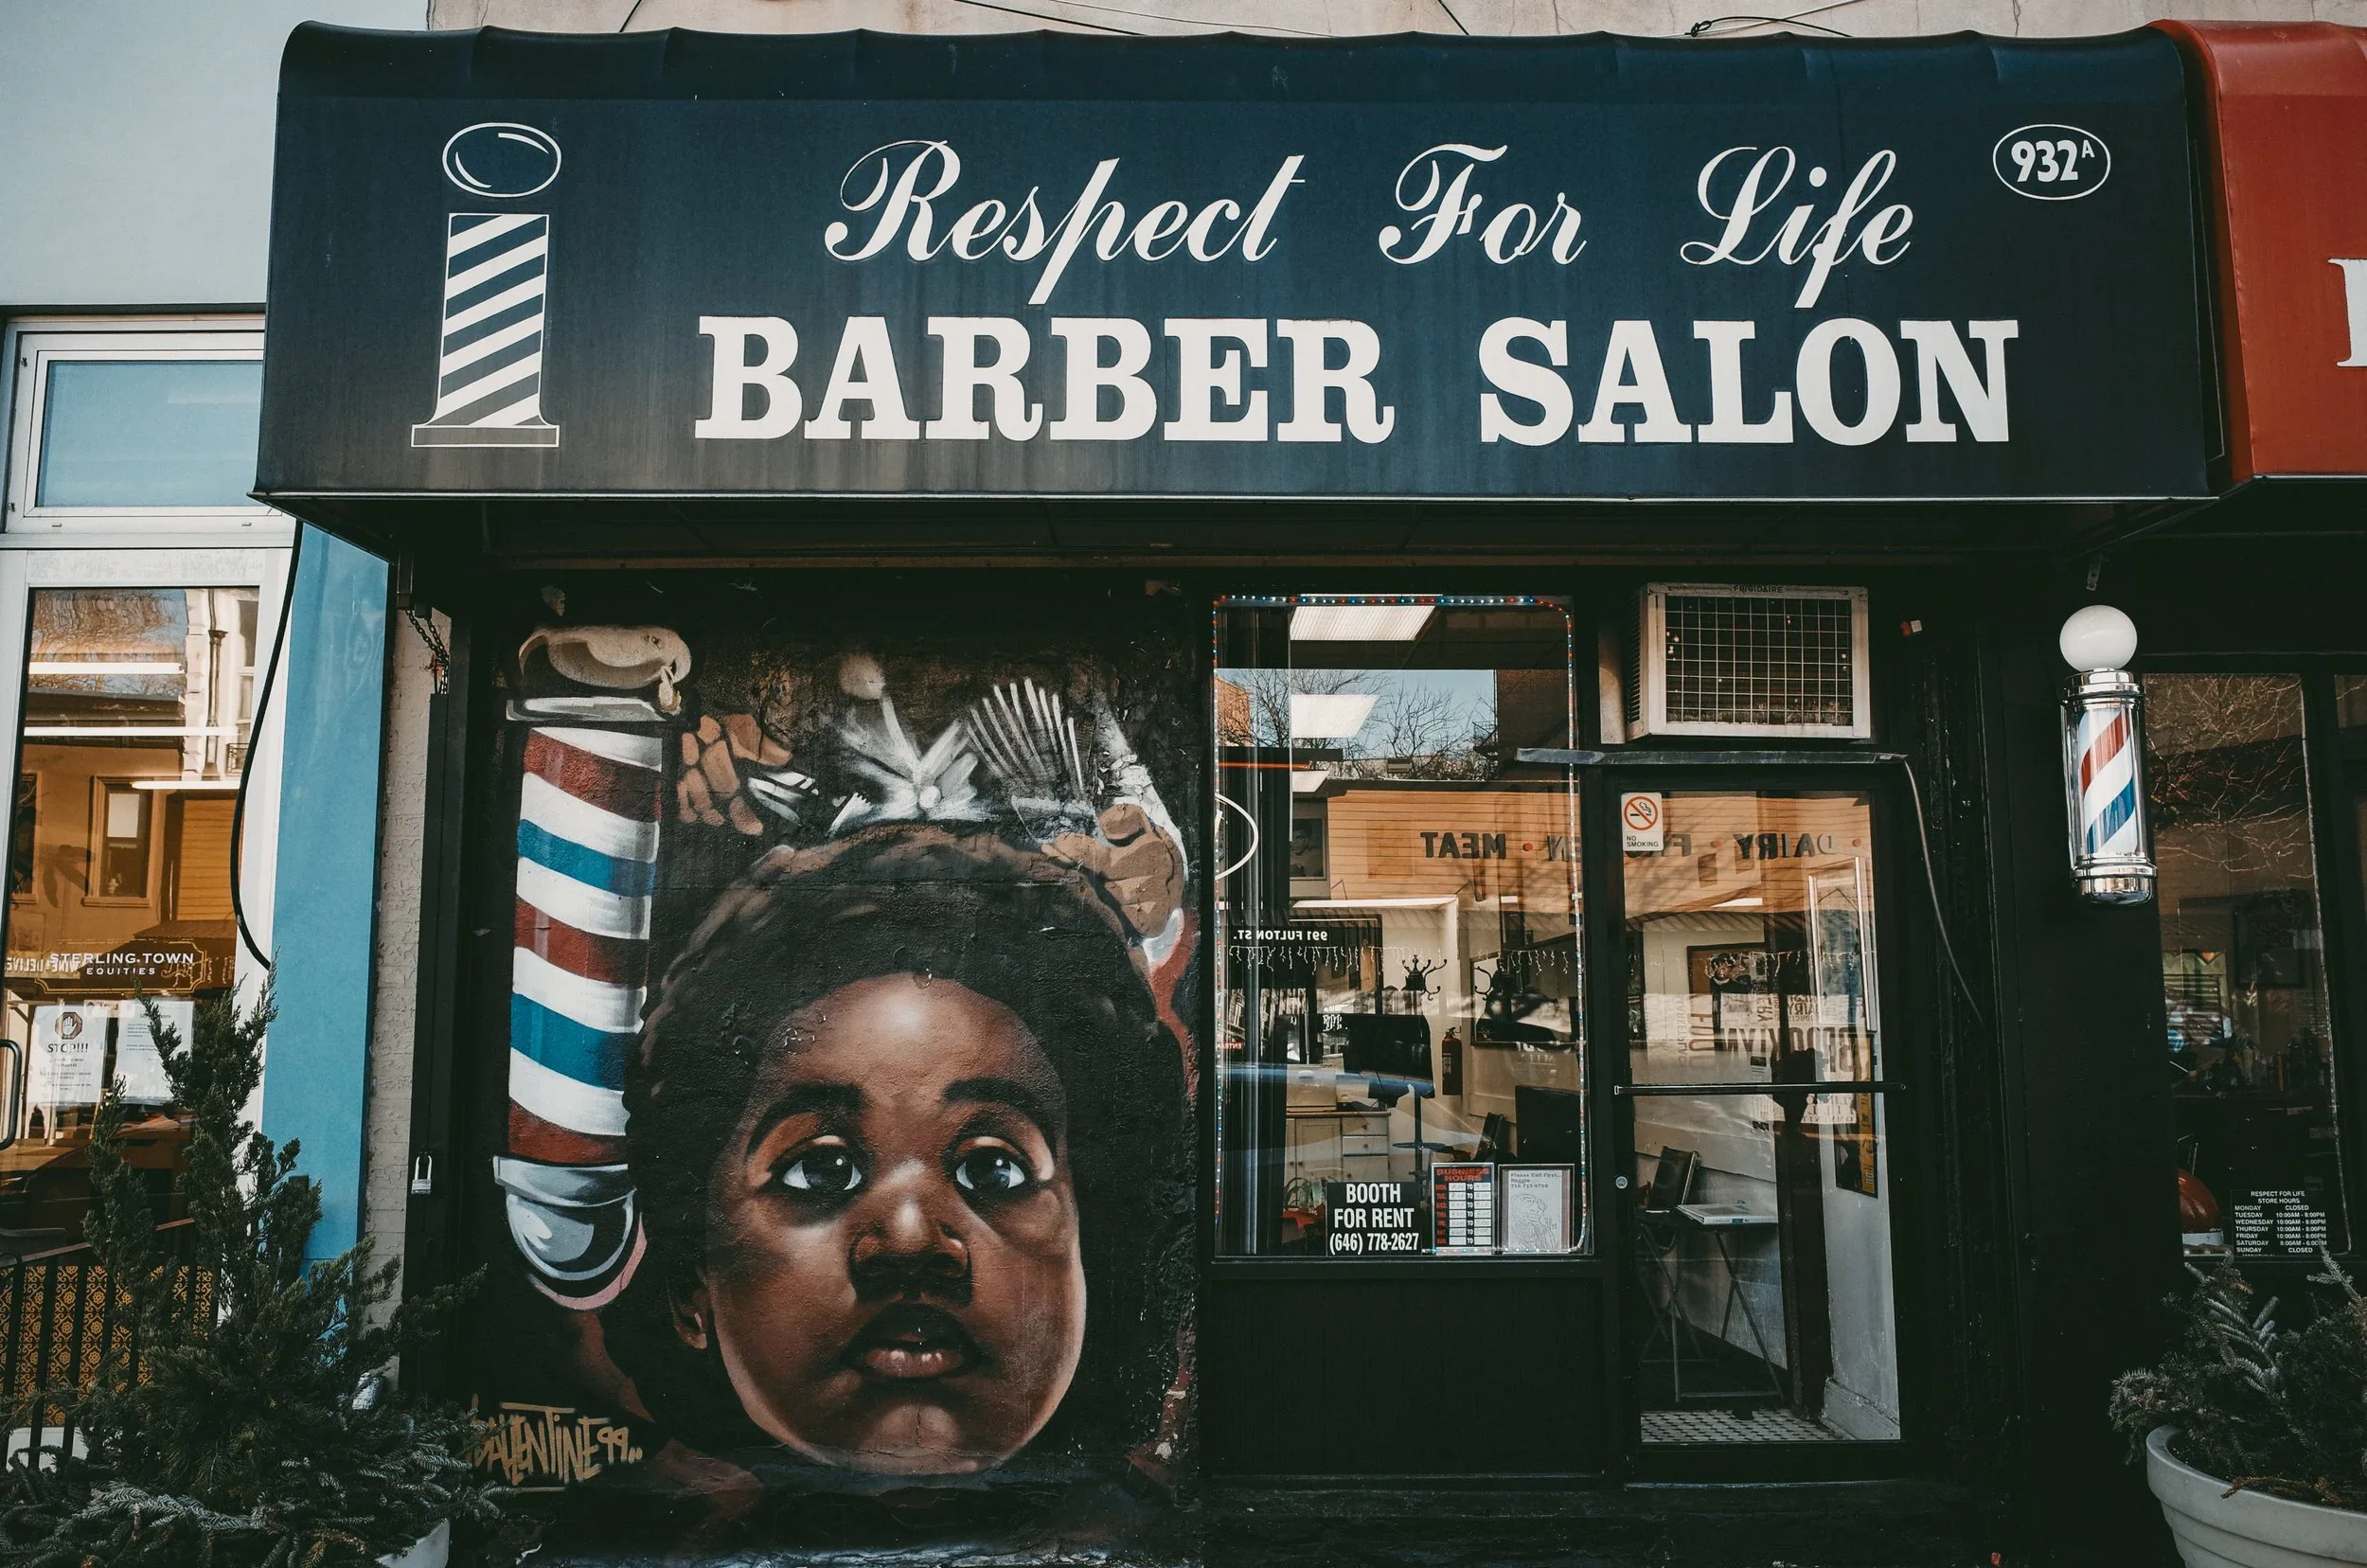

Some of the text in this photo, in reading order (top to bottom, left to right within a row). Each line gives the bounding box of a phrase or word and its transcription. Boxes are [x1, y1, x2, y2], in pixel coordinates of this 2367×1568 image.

[825, 140, 1913, 309] Respect For Life
[694, 315, 2019, 447] BARBER SALON
[1734, 584, 1784, 594] FRIGIDAIRE
[86, 967, 156, 975] EQUITIES
[47, 1043, 89, 1053] STOP!!!
[1436, 1167, 1490, 1176] BUSINESS
[1345, 1183, 1401, 1204] BOOTH
[1334, 1207, 1415, 1229] FOR RENT
[1329, 1233, 1419, 1256] (646) 778-2627
